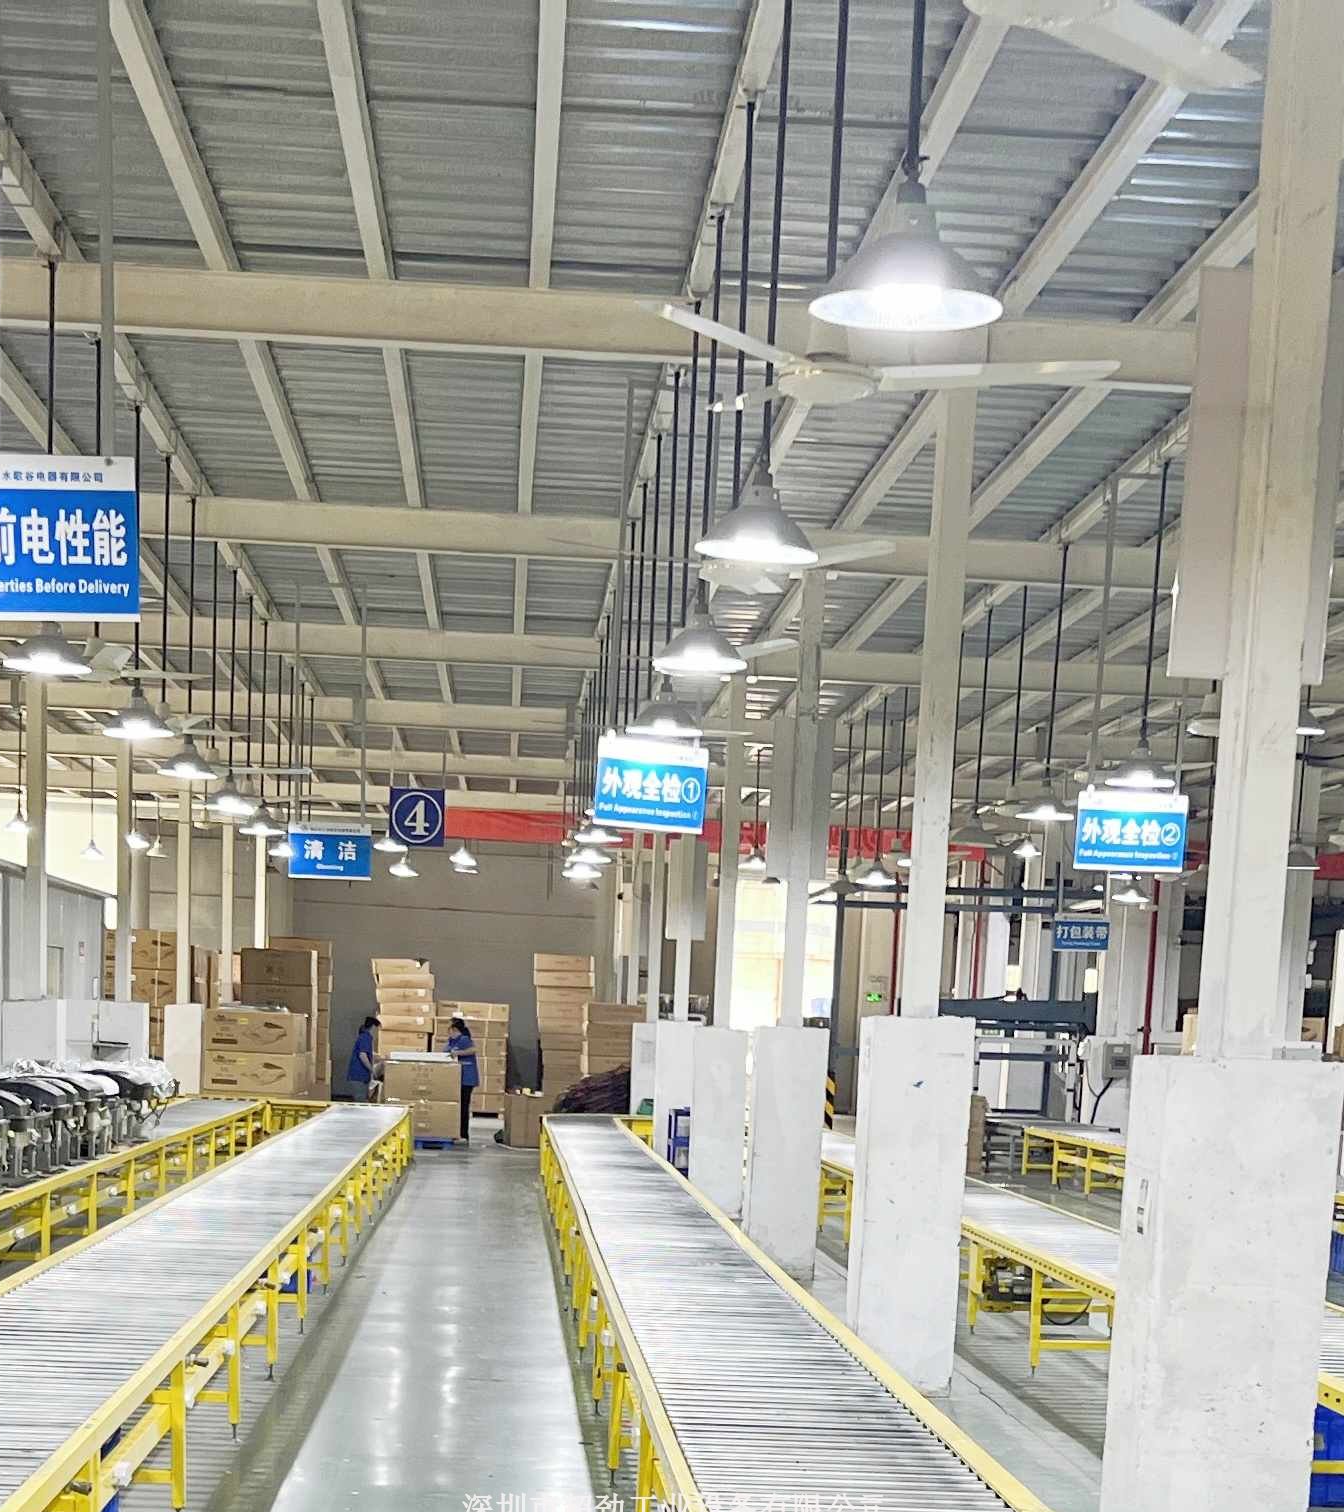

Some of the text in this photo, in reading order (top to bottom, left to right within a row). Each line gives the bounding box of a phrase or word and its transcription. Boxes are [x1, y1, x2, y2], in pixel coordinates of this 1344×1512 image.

[35, 579, 76, 594] Before
[79, 579, 130, 597] Delivery
[304, 839, 357, 861] 清洁
